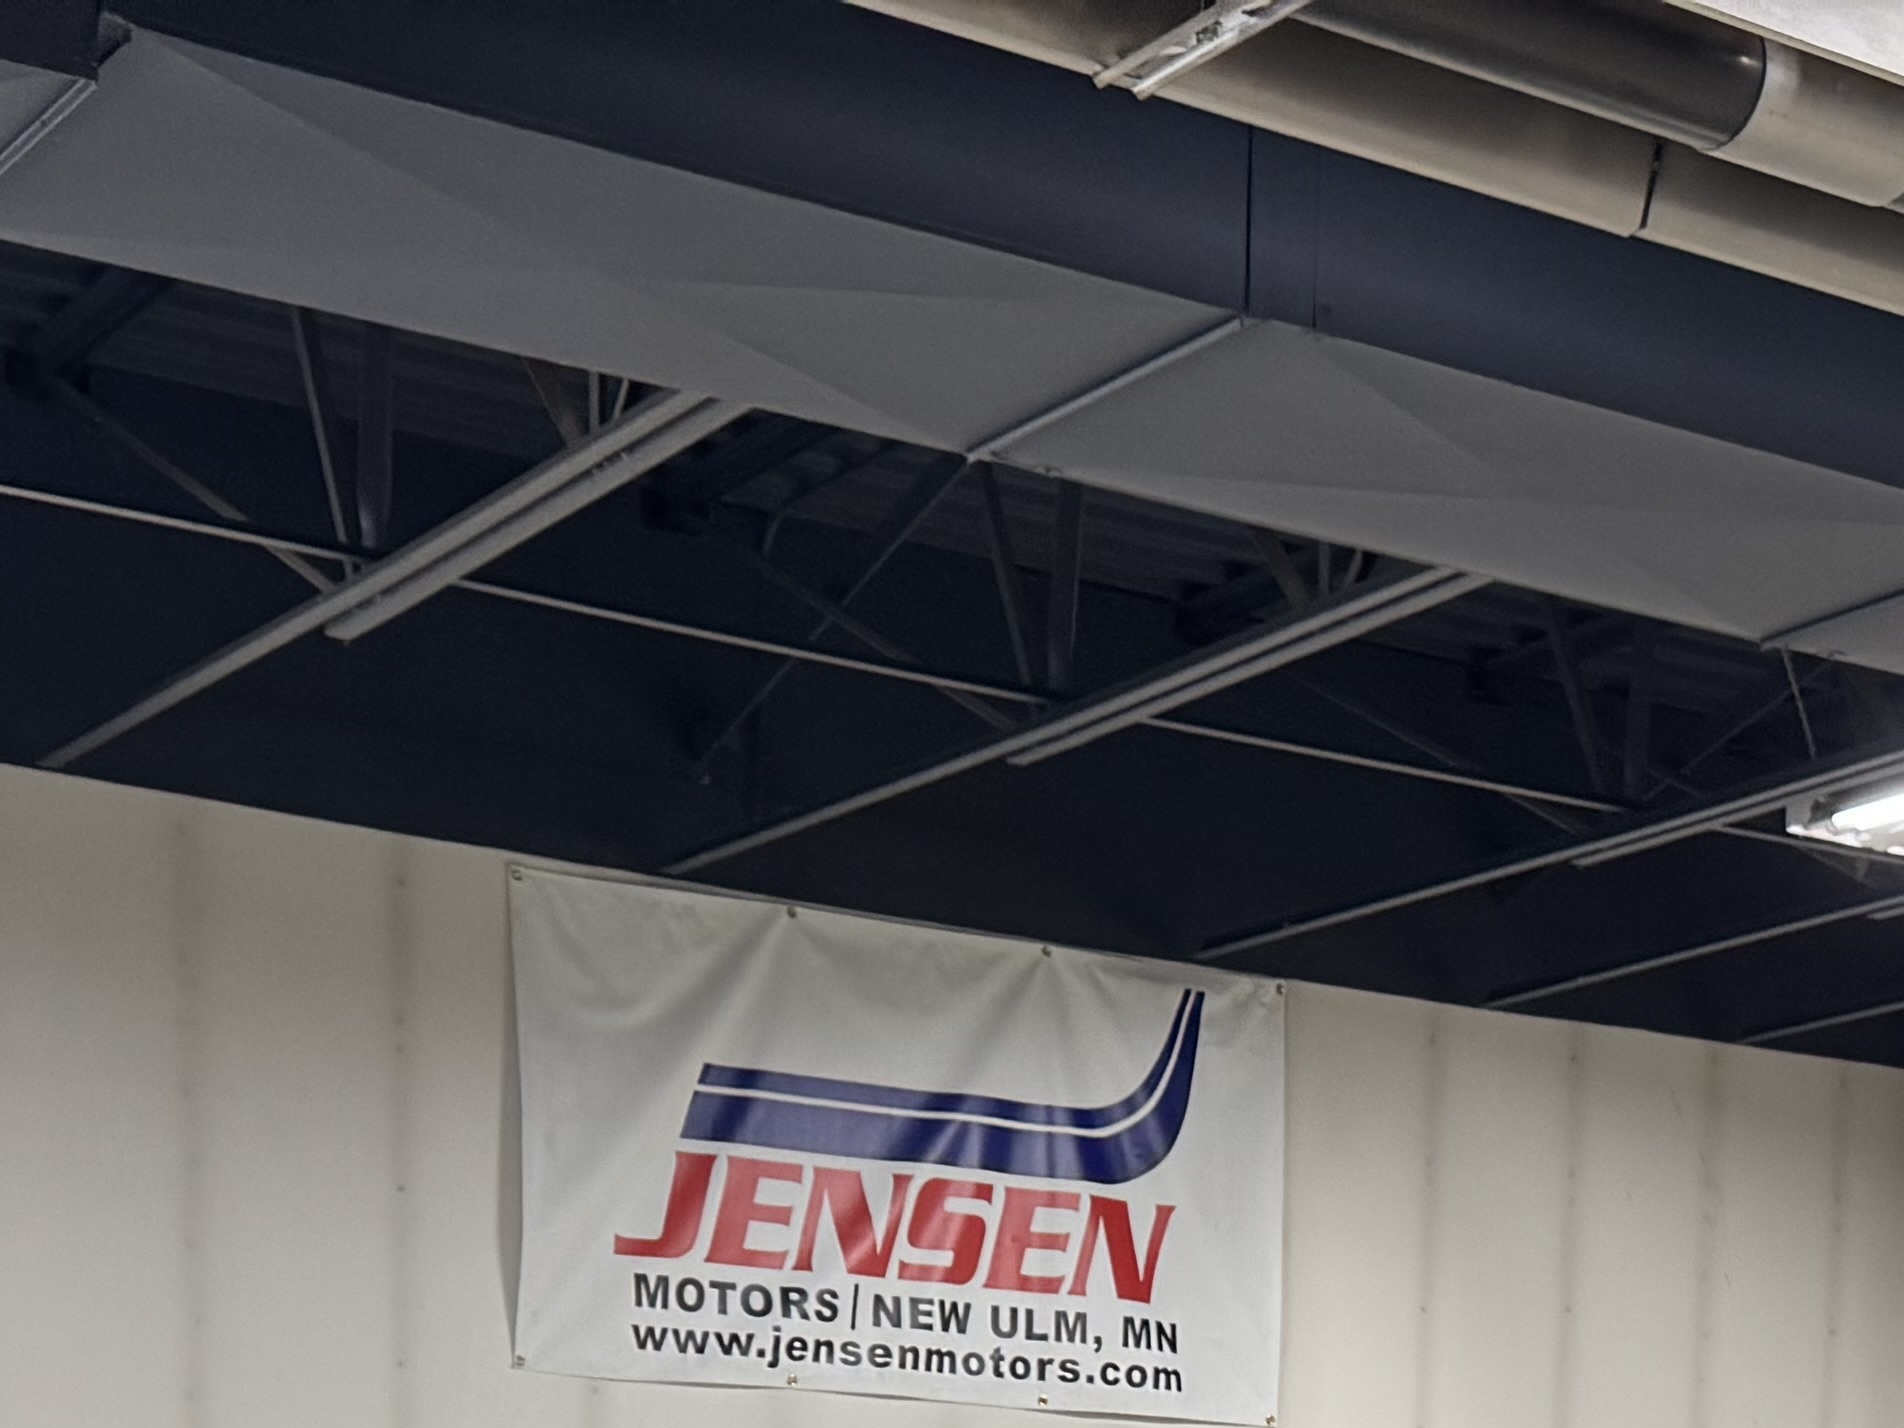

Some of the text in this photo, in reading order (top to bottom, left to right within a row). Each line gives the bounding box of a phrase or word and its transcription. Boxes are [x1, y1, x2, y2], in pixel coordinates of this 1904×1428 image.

[613, 1150, 1177, 1304] JENSEN
[633, 1272, 839, 1323] MOTORS
[872, 1293, 972, 1335] NEW
[990, 1304, 1103, 1353] ULM,
[1121, 1315, 1178, 1354] MN
[631, 1323, 1183, 1392] www.jensenmotors.com
